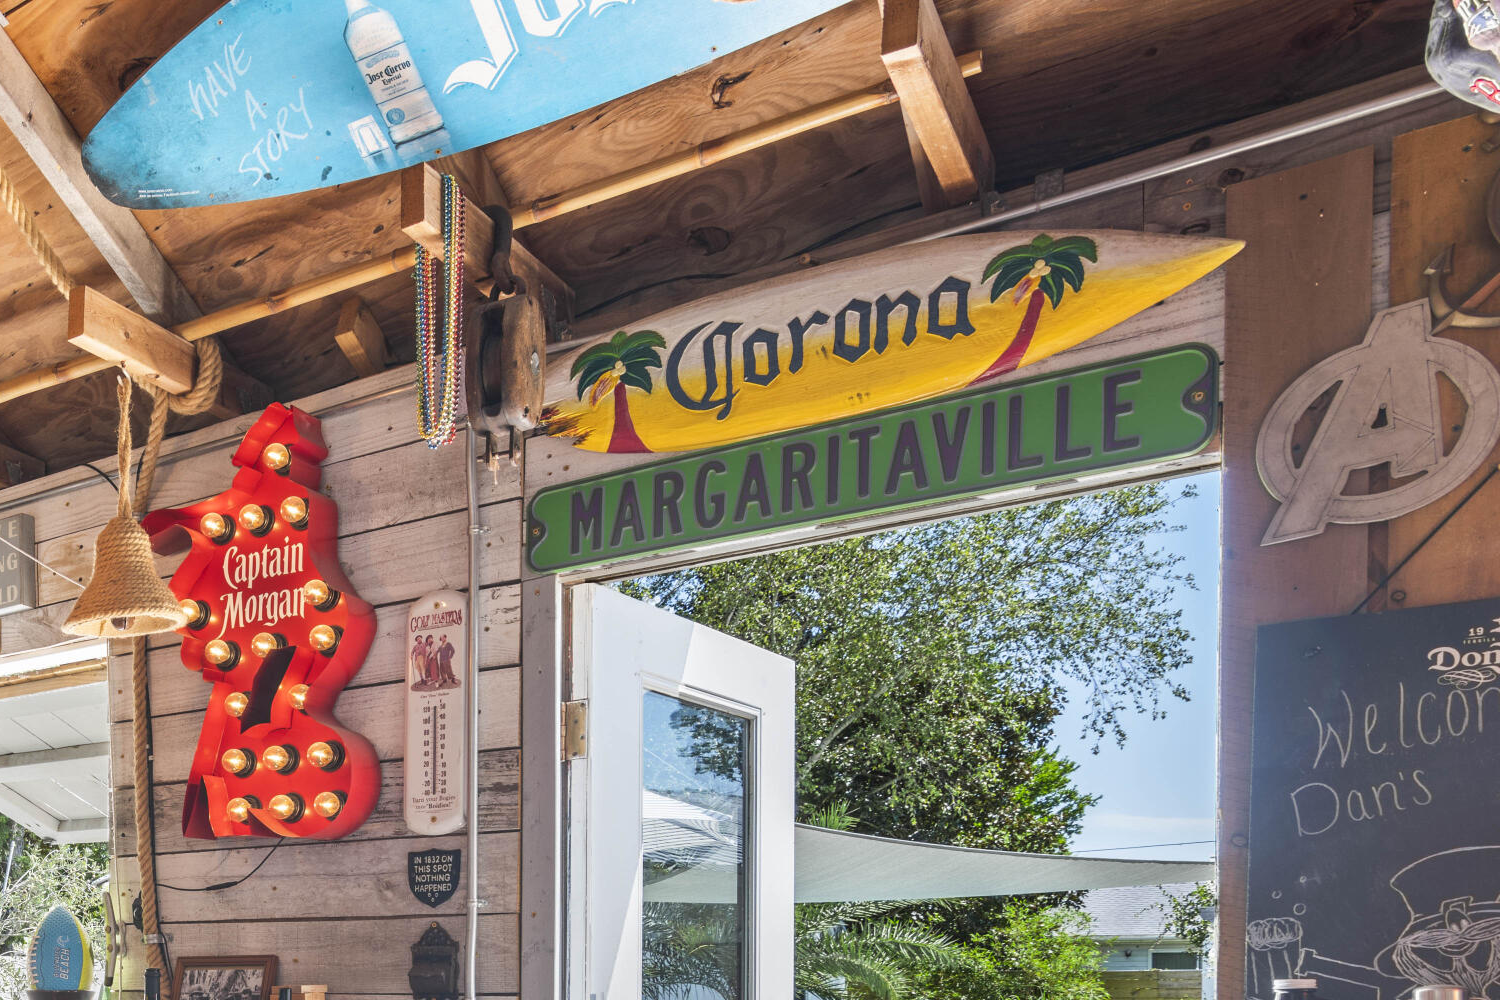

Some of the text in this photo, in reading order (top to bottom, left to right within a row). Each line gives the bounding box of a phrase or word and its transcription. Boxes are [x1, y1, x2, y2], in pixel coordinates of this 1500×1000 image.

[190, 32, 254, 123] HAVE
[365, 60, 412, 85] Jose Cuervo
[245, 89, 268, 131] A
[238, 82, 314, 188] STORY
[665, 276, 978, 423] Corona
[570, 370, 1142, 556] MARGARITAVILLE
[222, 536, 305, 590] Captain
[216, 587, 306, 641] Morgan
[1468, 627, 1485, 637] 19
[1290, 769, 1432, 837] Dan's
[413, 855, 453, 865] IN 1832 ON
[413, 864, 453, 874] THIS SPOT
[415, 873, 451, 883] NOTHING
[414, 883, 453, 893] HAPPENED
[60, 948, 71, 980] BEACH
